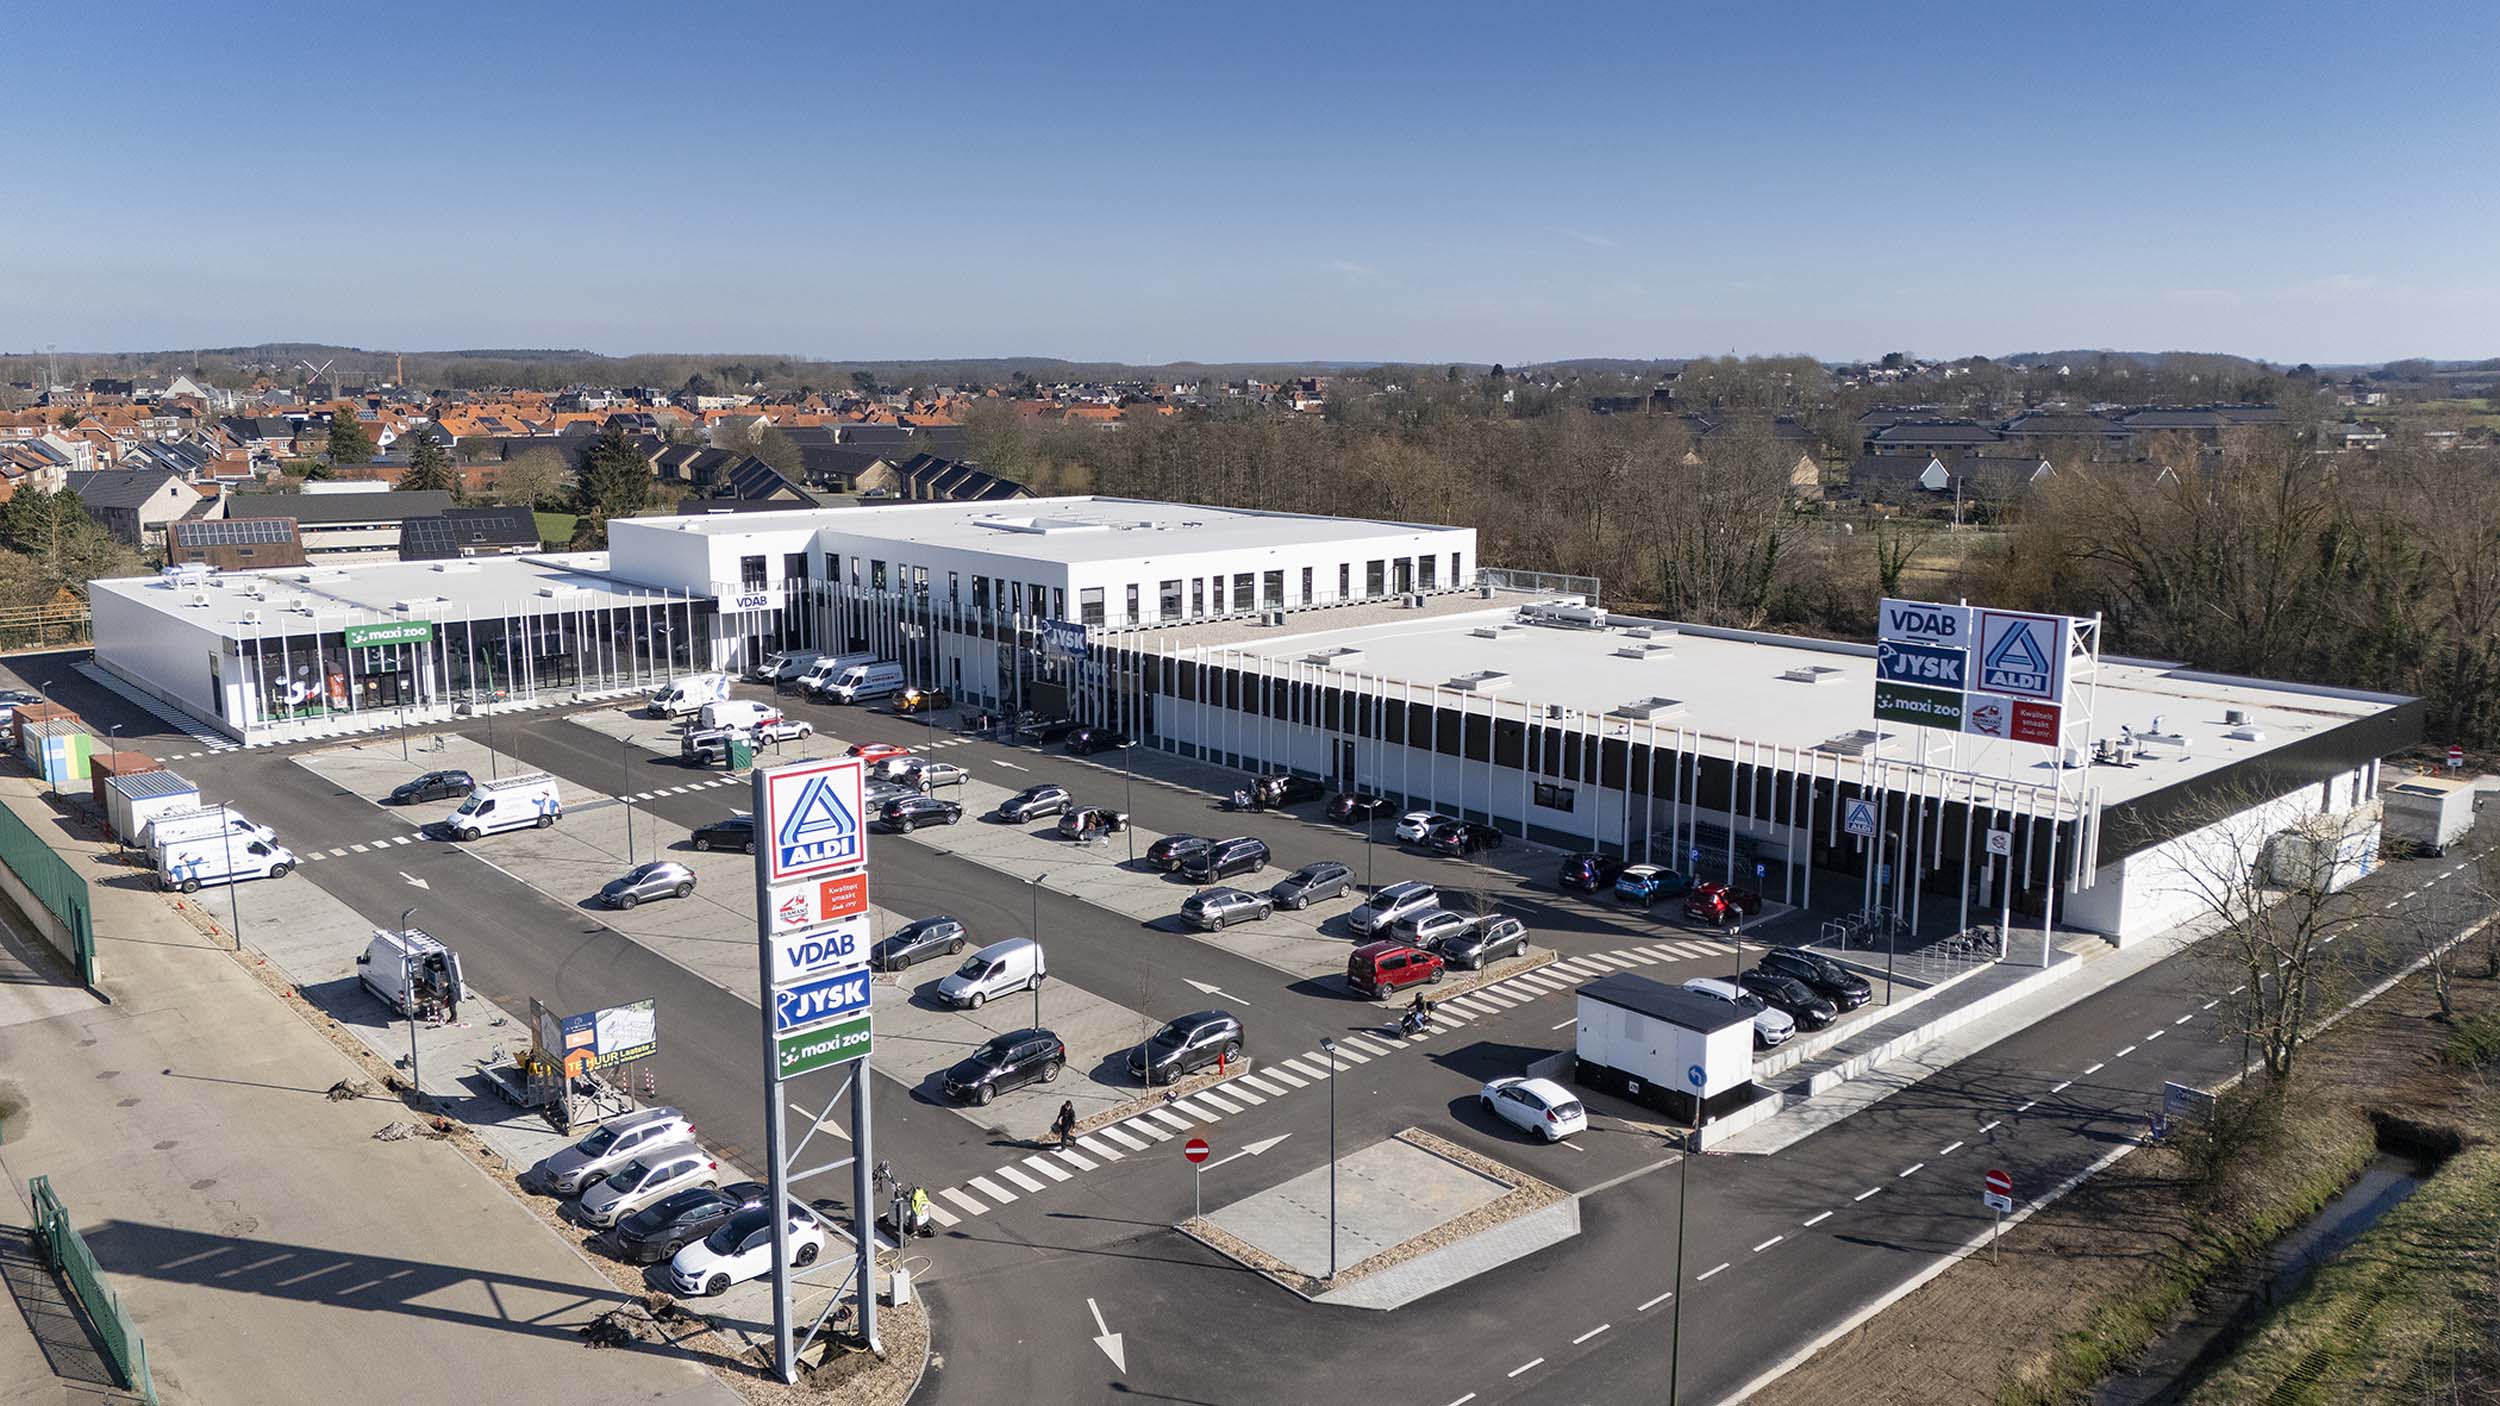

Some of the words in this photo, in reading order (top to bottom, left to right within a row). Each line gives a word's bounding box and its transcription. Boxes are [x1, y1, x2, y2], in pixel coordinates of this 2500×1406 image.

[736, 595, 767, 608] VDAB
[1890, 609, 1956, 636] VDAB
[368, 626, 402, 640] maxi
[403, 627, 427, 638] zoo
[1051, 628, 1085, 650] JYSK
[1893, 653, 1960, 681] JYSK
[1990, 671, 2042, 690] ALDI
[1895, 697, 1932, 713] maxi
[1933, 704, 1961, 718] zoo
[1849, 822, 1873, 833] ALDI
[788, 836, 851, 867] ALDI
[1692, 849, 1699, 859] P
[1757, 864, 1765, 875] P
[828, 882, 859, 895] Kwaliteit
[787, 934, 856, 968] VDAB
[796, 978, 865, 1017] JYSK
[801, 1034, 841, 1059] maxi
[842, 1030, 870, 1046] zoo
[568, 1060, 583, 1072] TE
[586, 1052, 619, 1070] HUUR
